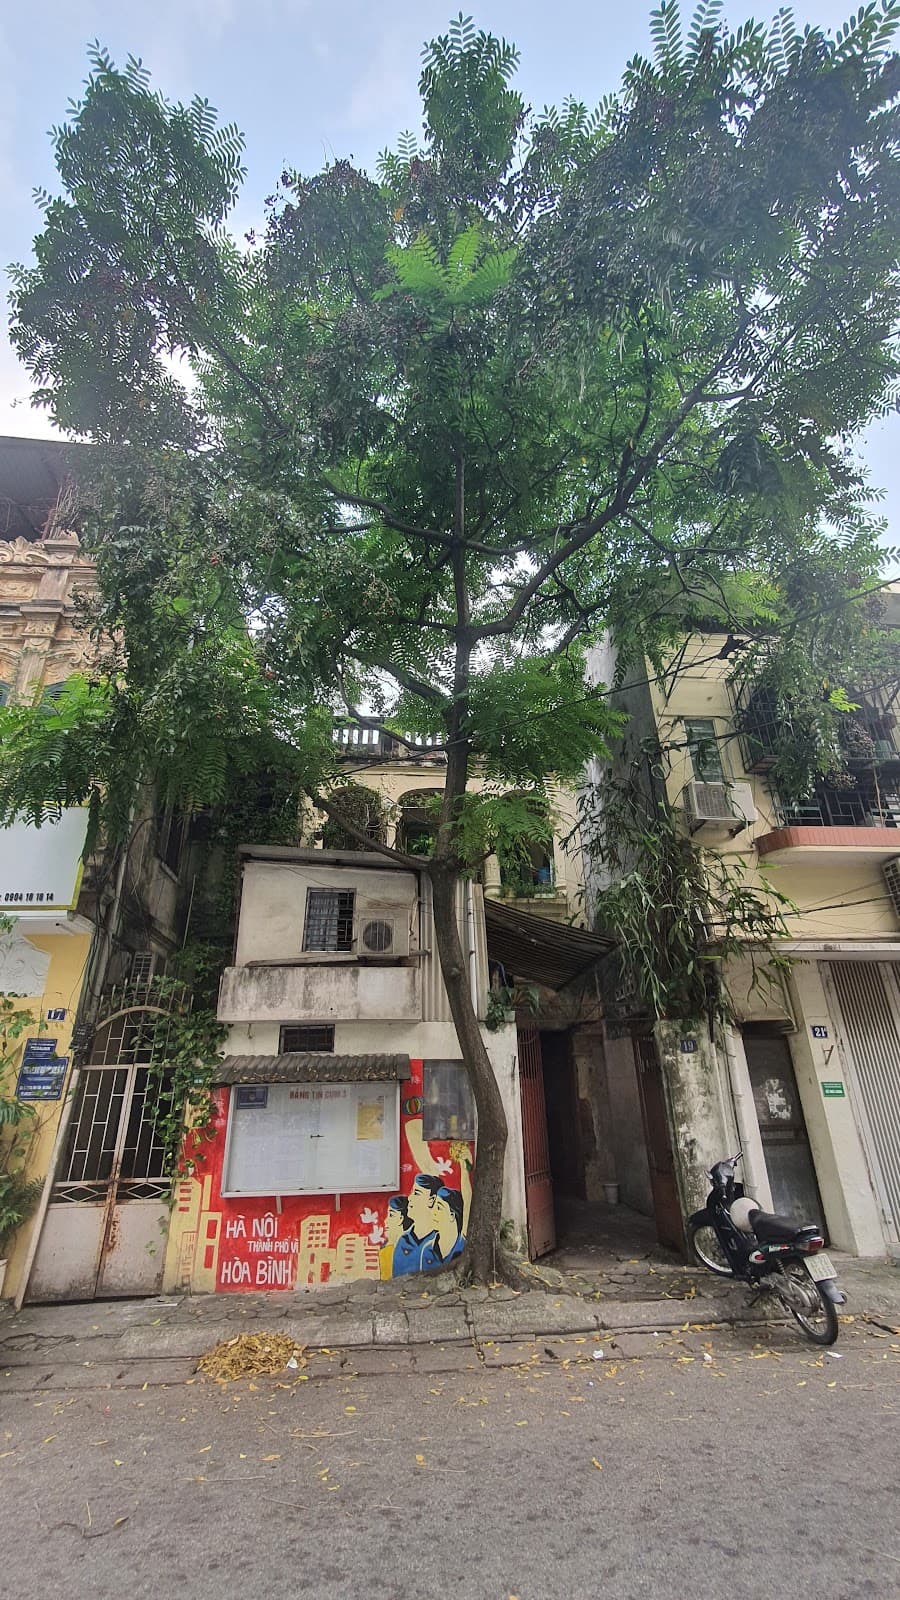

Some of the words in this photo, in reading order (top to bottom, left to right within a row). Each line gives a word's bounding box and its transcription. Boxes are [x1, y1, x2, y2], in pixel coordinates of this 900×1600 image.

[226, 1214, 247, 1239] HÀ
[247, 1239, 273, 1252] THÀNH
[274, 1236, 290, 1253] PHỐ
[290, 1238, 299, 1254] VÌ
[221, 1256, 251, 1284] HÒA
[255, 1256, 292, 1285] BÌNH
